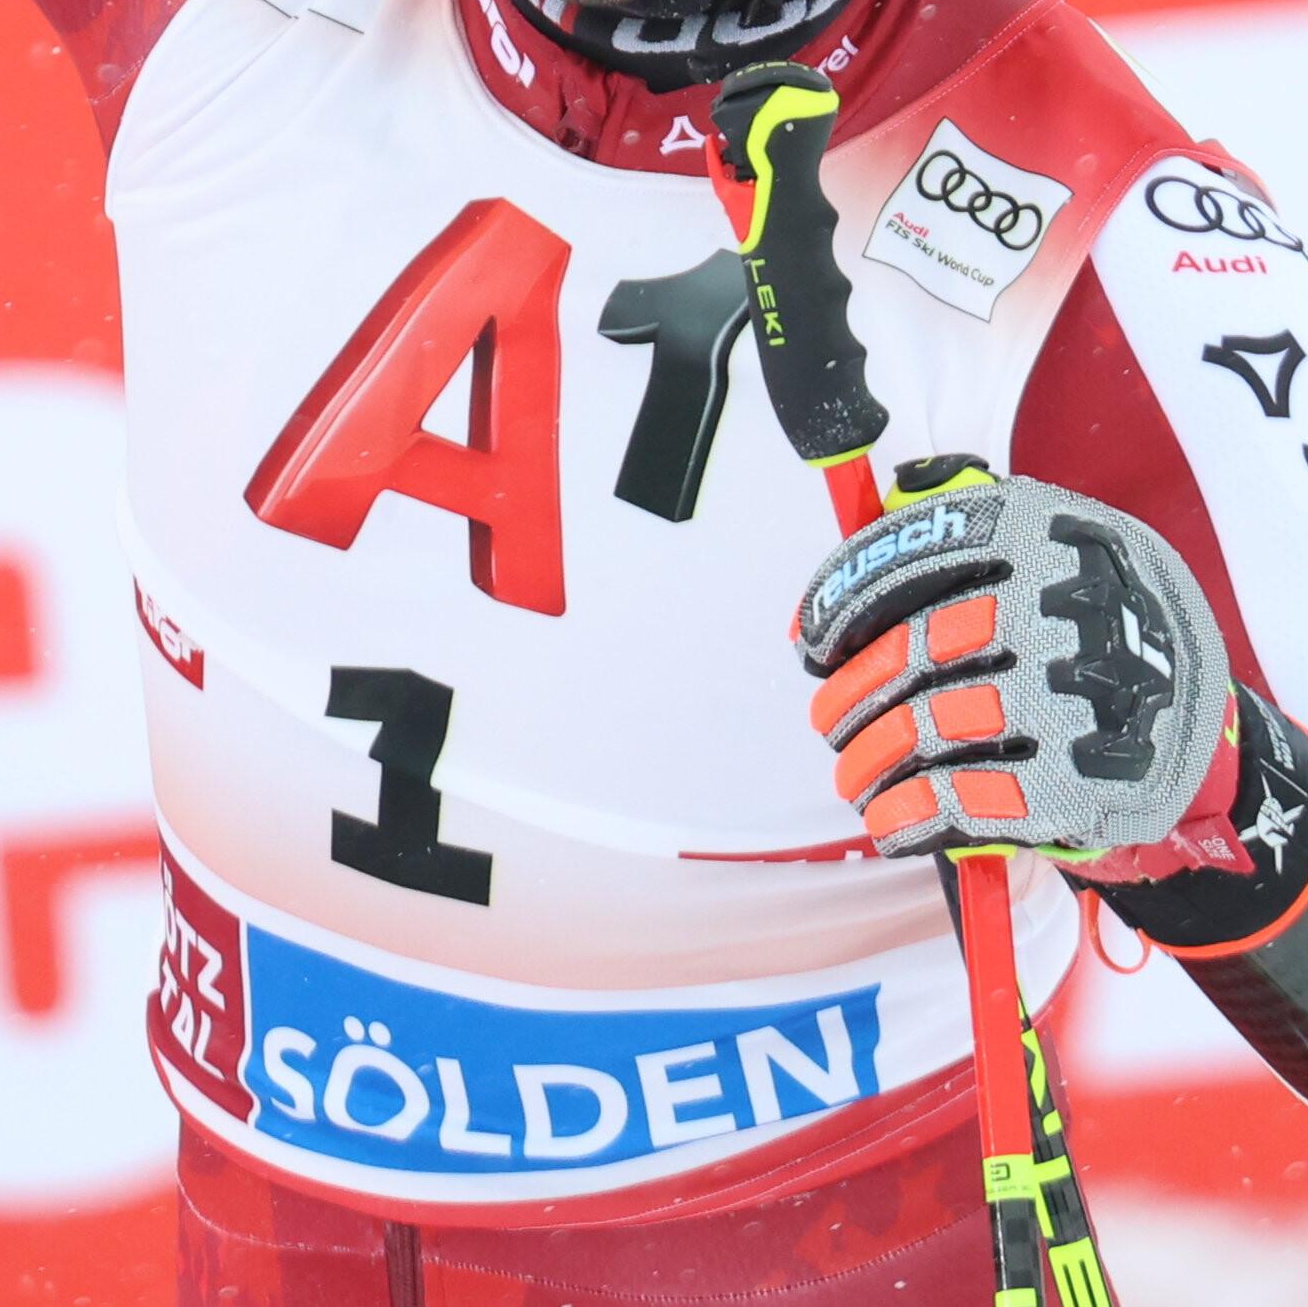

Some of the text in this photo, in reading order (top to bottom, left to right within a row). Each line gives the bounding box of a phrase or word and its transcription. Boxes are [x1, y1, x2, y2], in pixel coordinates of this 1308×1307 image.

[885, 219, 995, 288] FIS Ski World Cup
[892, 211, 930, 239] Audi
[1172, 249, 1268, 275] Audi
[750, 258, 785, 347] LEKI
[812, 504, 968, 626] reusch
[325, 665, 492, 907] 1
[263, 1004, 857, 1161] SÖLDEN
